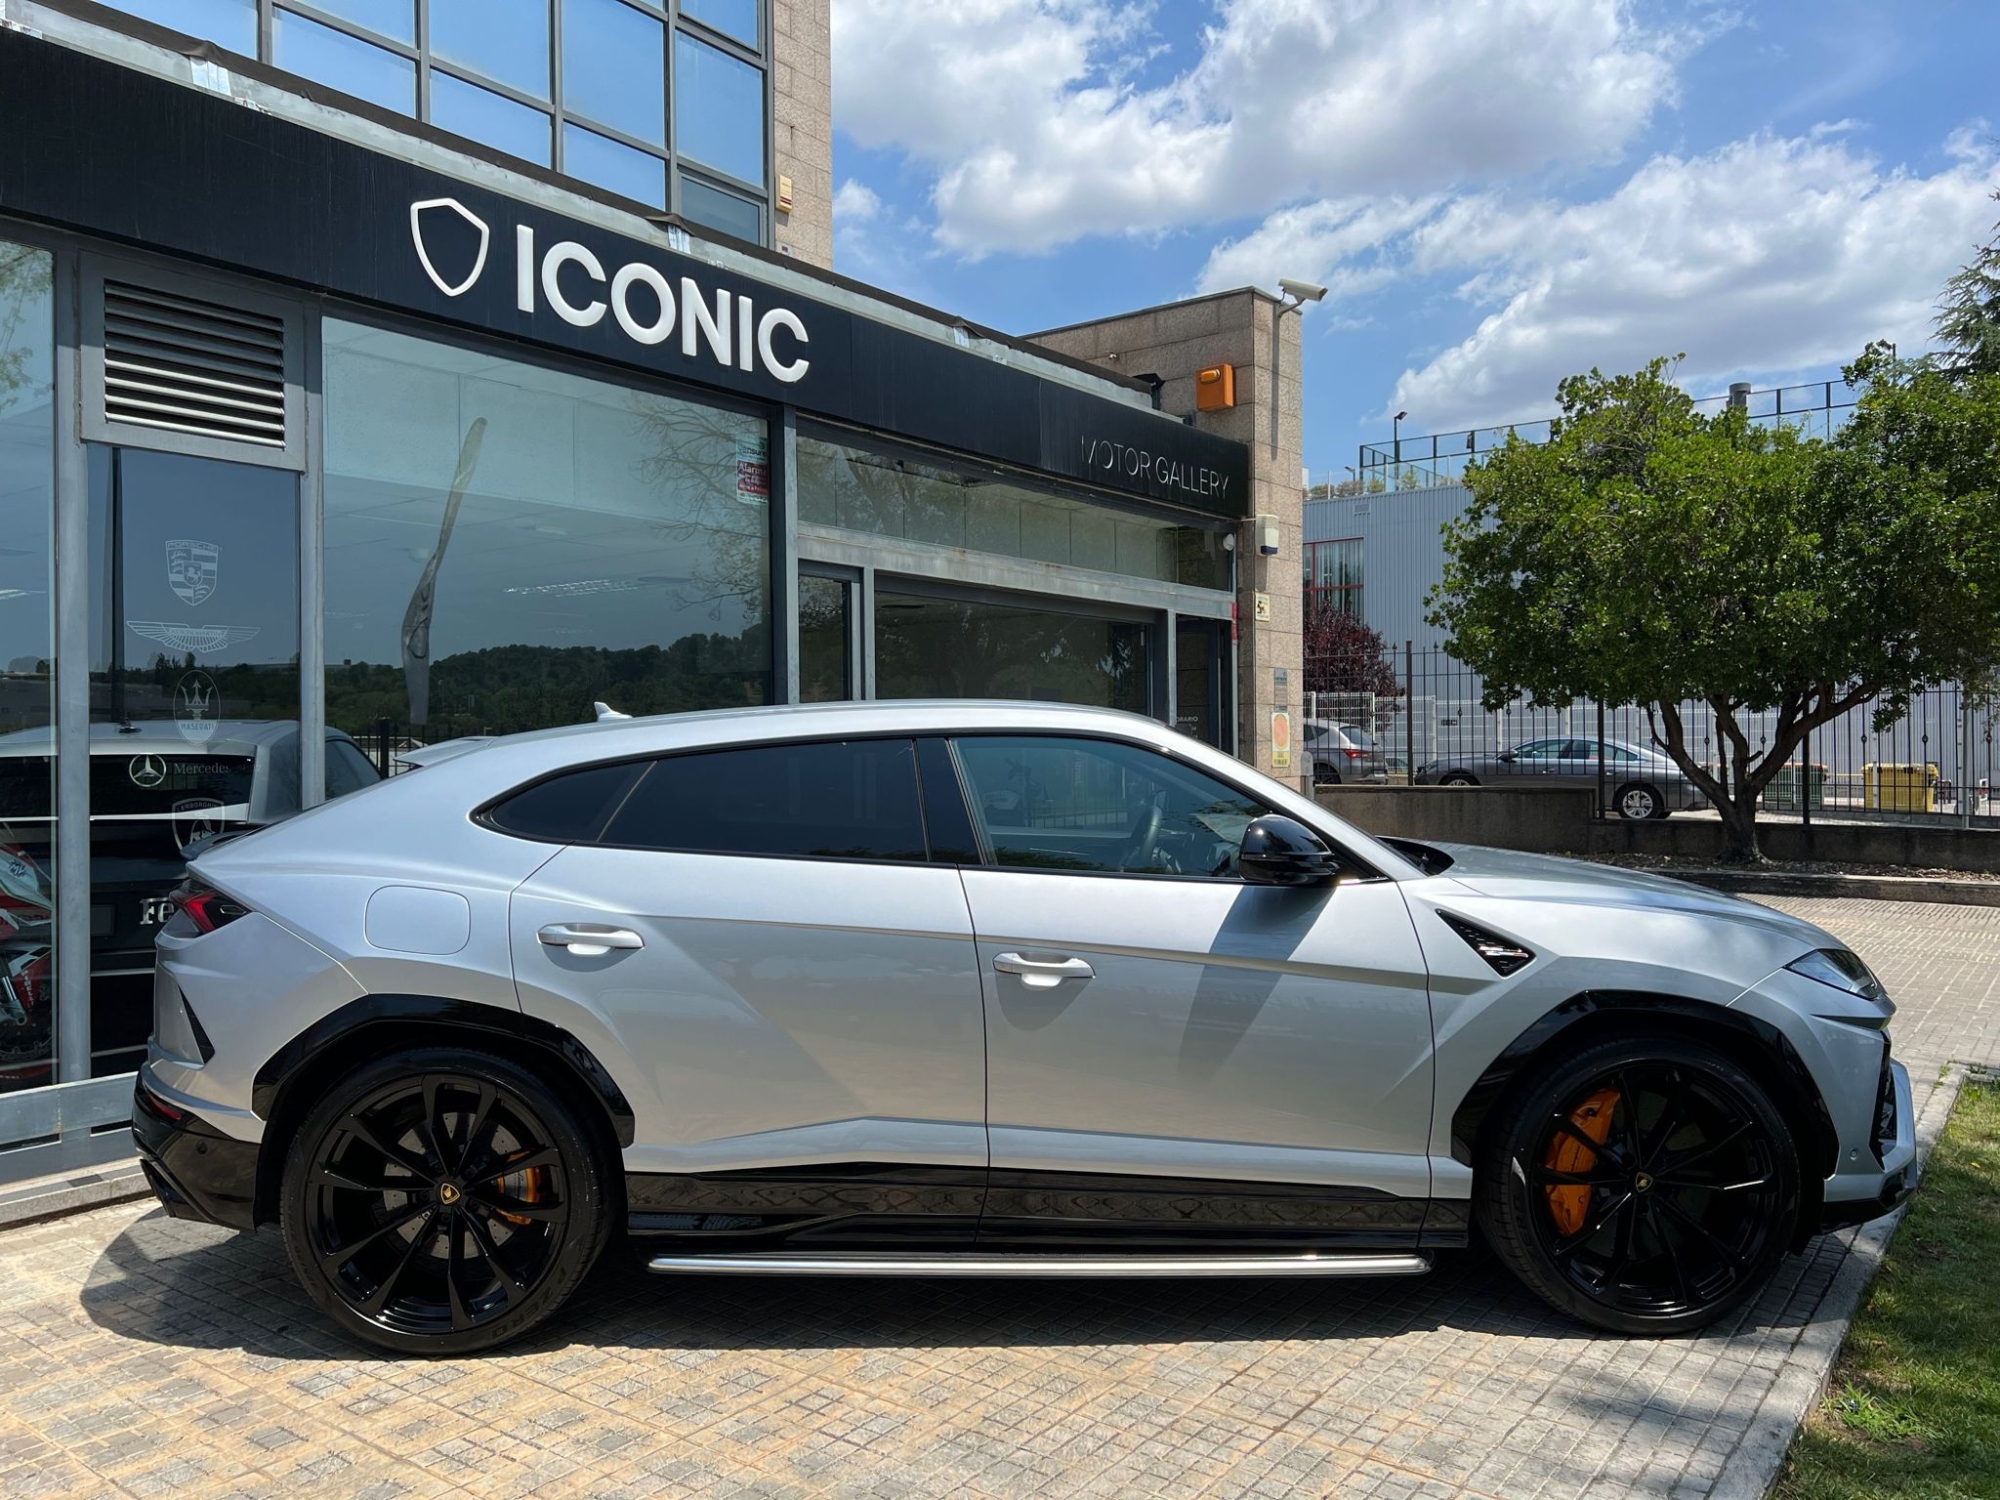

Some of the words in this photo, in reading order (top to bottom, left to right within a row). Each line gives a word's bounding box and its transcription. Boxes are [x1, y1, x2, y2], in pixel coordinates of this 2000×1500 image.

[516, 223, 810, 384] ICONIC
[1081, 434, 1151, 479] MOTOR
[1155, 456, 1230, 499] GALLERY
[168, 541, 218, 553] PORSCHE
[181, 722, 215, 731] MASERATI
